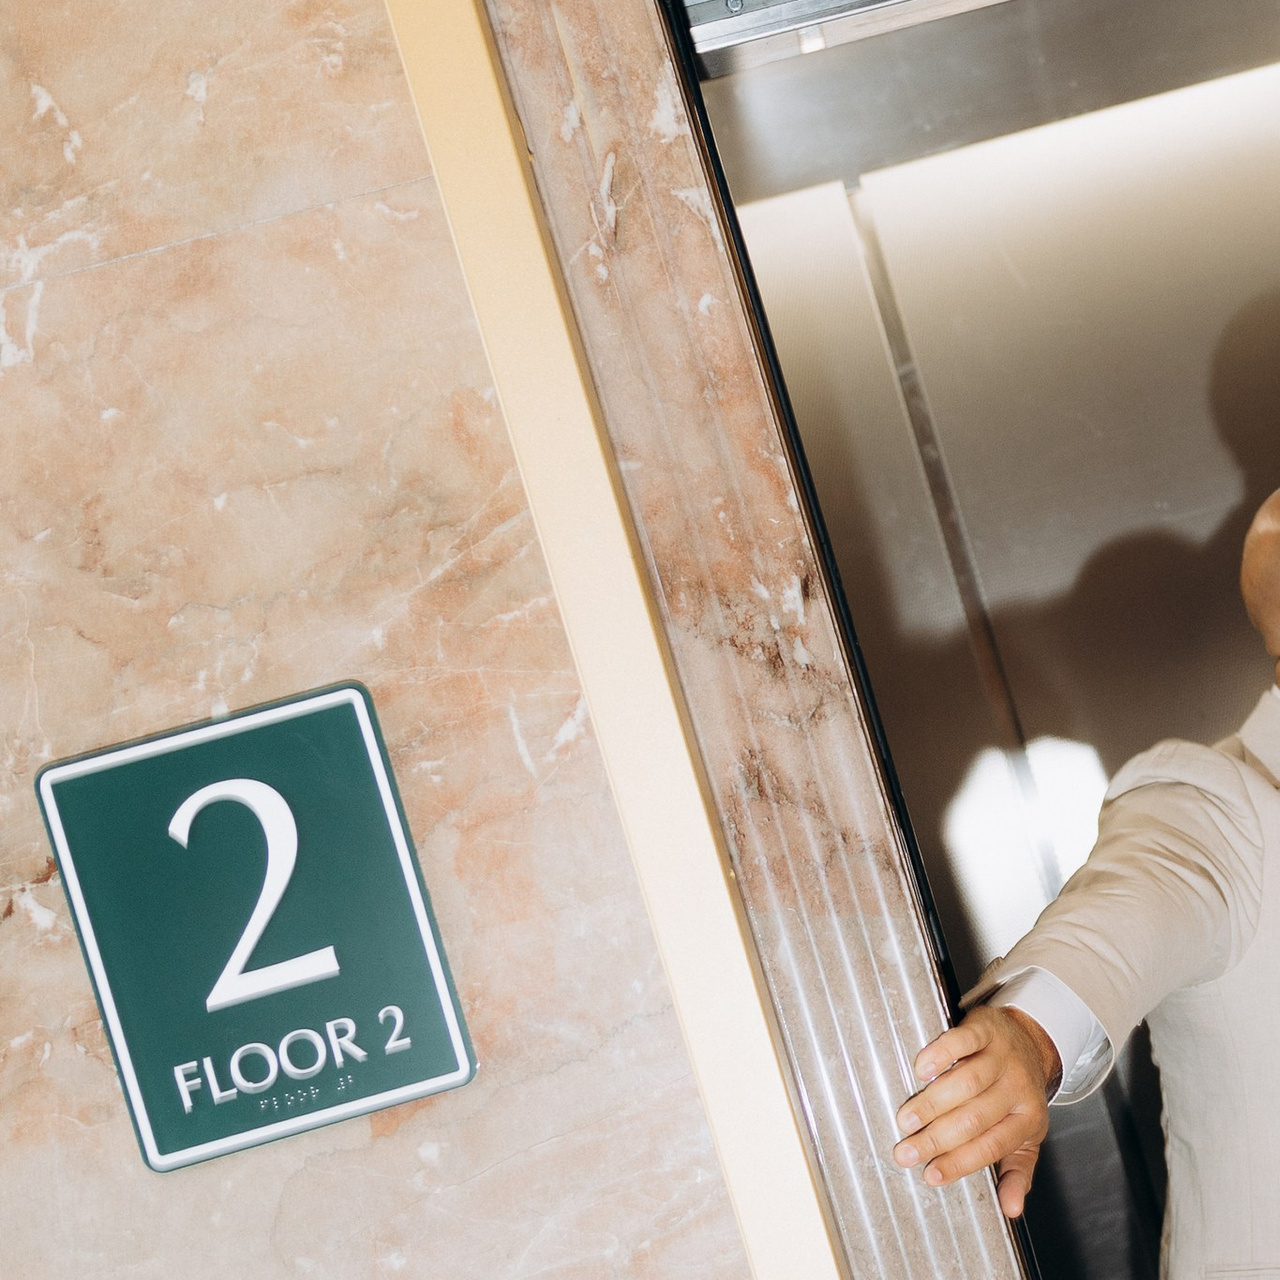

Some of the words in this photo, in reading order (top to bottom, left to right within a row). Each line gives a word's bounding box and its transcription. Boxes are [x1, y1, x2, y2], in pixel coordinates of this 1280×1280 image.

[167, 778, 341, 1013] 2
[173, 1017, 369, 1114] FLOOR
[377, 1005, 412, 1056] 2
